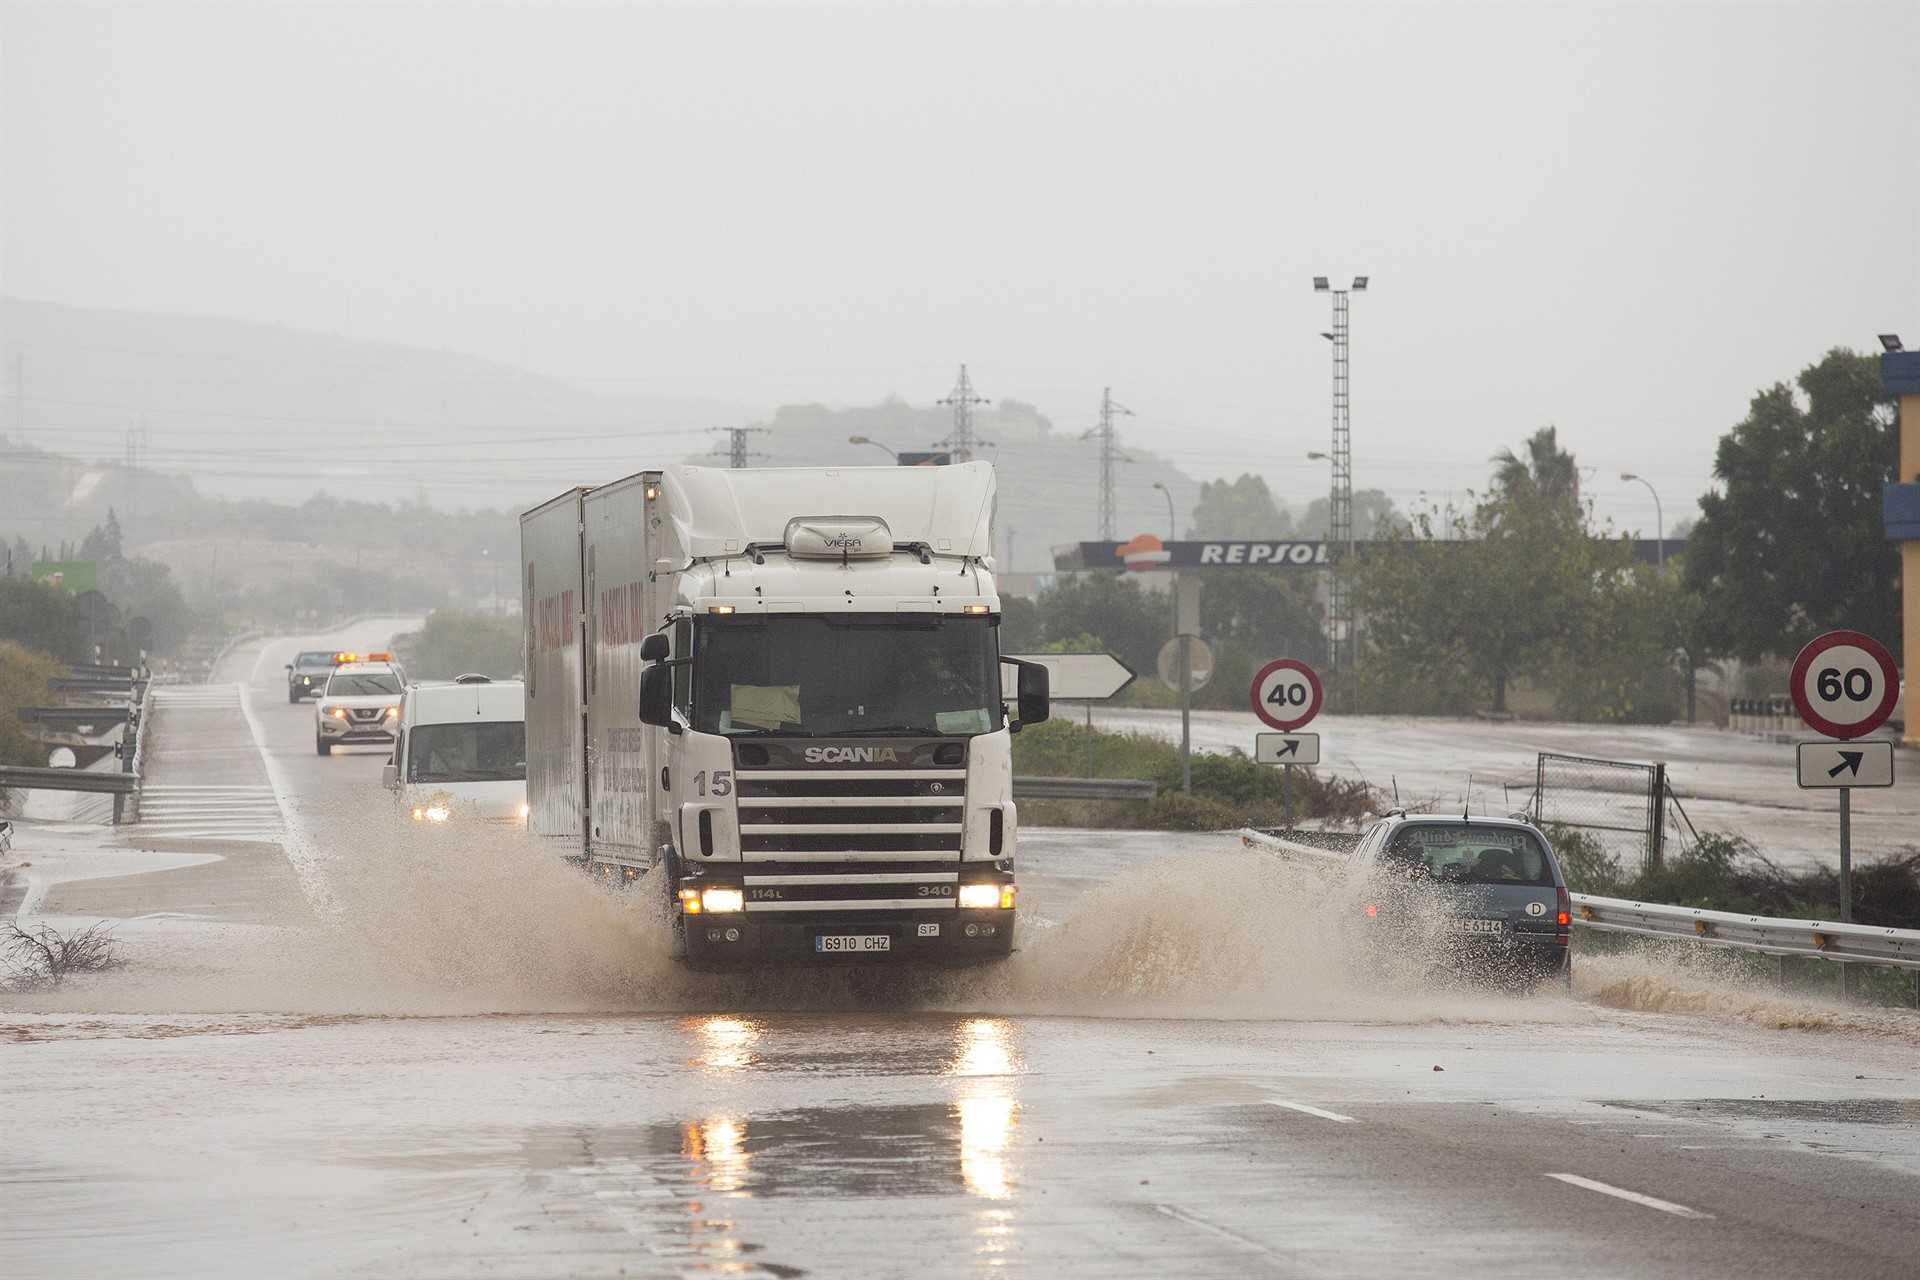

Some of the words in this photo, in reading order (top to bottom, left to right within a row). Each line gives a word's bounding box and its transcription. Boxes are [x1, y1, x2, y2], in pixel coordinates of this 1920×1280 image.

[1200, 543, 1330, 564] REPSOL
[1817, 667, 1873, 702] 60
[1267, 683, 1306, 706] 40
[804, 747, 898, 763] SCANIA
[693, 770, 732, 797] 15
[917, 886, 952, 896] 340
[1532, 903, 1541, 915] D
[825, 937, 857, 950] 6910
[864, 937, 888, 949] CHZ
